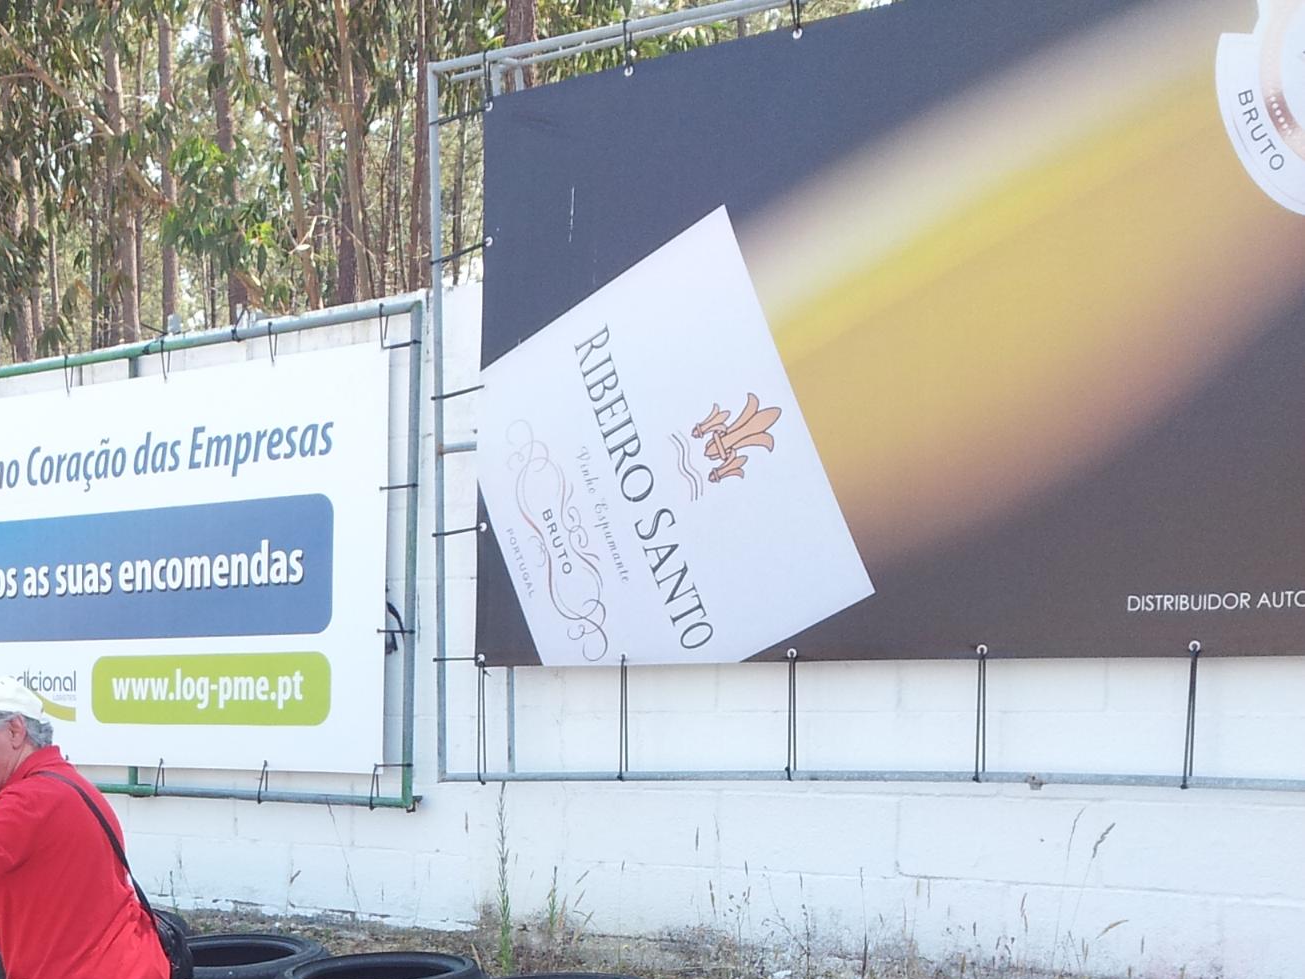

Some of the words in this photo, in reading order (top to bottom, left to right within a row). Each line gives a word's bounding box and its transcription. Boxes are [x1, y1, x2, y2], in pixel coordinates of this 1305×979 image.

[1238, 89, 1285, 171] BRUTO
[27, 437, 127, 493] Coração
[134, 431, 181, 476] das
[188, 421, 335, 478] Empresas
[574, 323, 655, 503] RIBEIRO
[634, 508, 714, 650] SANTO
[542, 508, 573, 575] BRUTO
[576, 446, 599, 494] Vinho
[594, 498, 629, 583] Espumante
[23, 564, 49, 597] as
[55, 561, 112, 596] suas
[118, 539, 304, 592] encomendas
[505, 528, 535, 598] PORTUGAL
[1127, 592, 1252, 612] DISTRIBUIDOR
[112, 668, 304, 710] www.log-pme.pt
